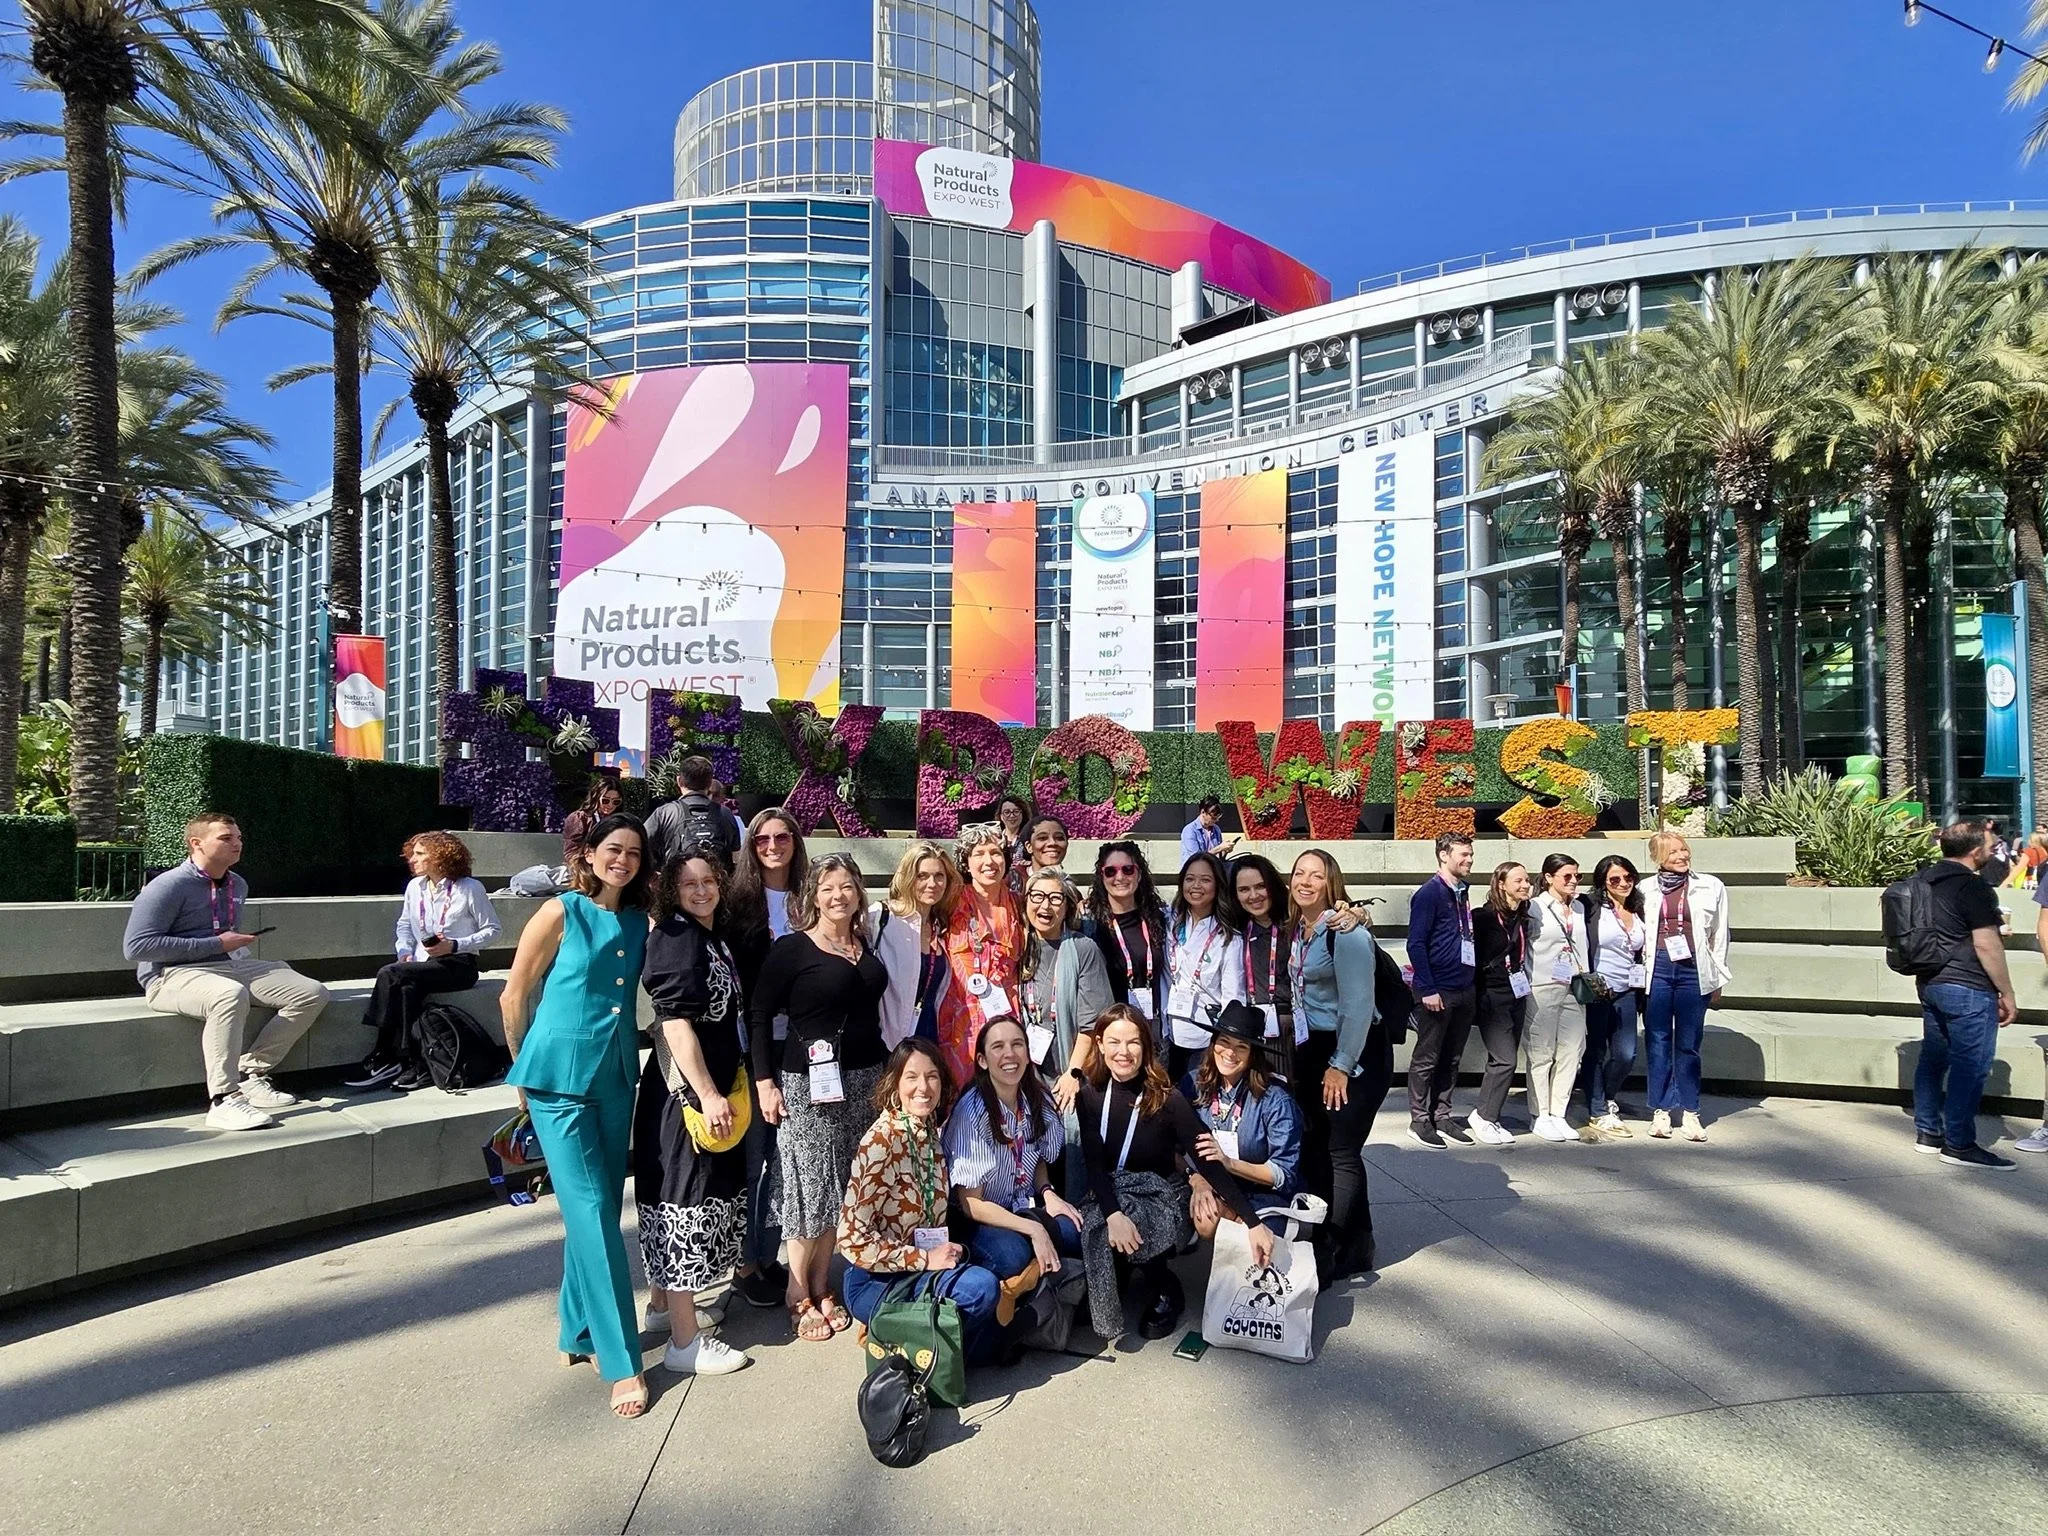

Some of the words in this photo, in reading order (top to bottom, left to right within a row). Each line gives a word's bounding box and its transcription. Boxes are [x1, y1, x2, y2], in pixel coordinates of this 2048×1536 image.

[934, 163, 987, 181] Natural
[934, 176, 999, 197] Products
[934, 192, 966, 204] EXPO
[968, 197, 1000, 209] WEST
[886, 484, 1039, 506] ANAHEIM
[1071, 448, 1301, 498] CONVENTION
[1339, 393, 1489, 453] CENTER
[1374, 451, 1396, 512] NEW
[1373, 522, 1396, 600] HOPE
[581, 597, 710, 634] Natural
[581, 634, 740, 671] Products
[1372, 608, 1395, 731] NETWOR
[596, 679, 650, 704] XPO
[1215, 707, 1740, 840] WEST
[1223, 1317, 1282, 1340] COYOTAS
